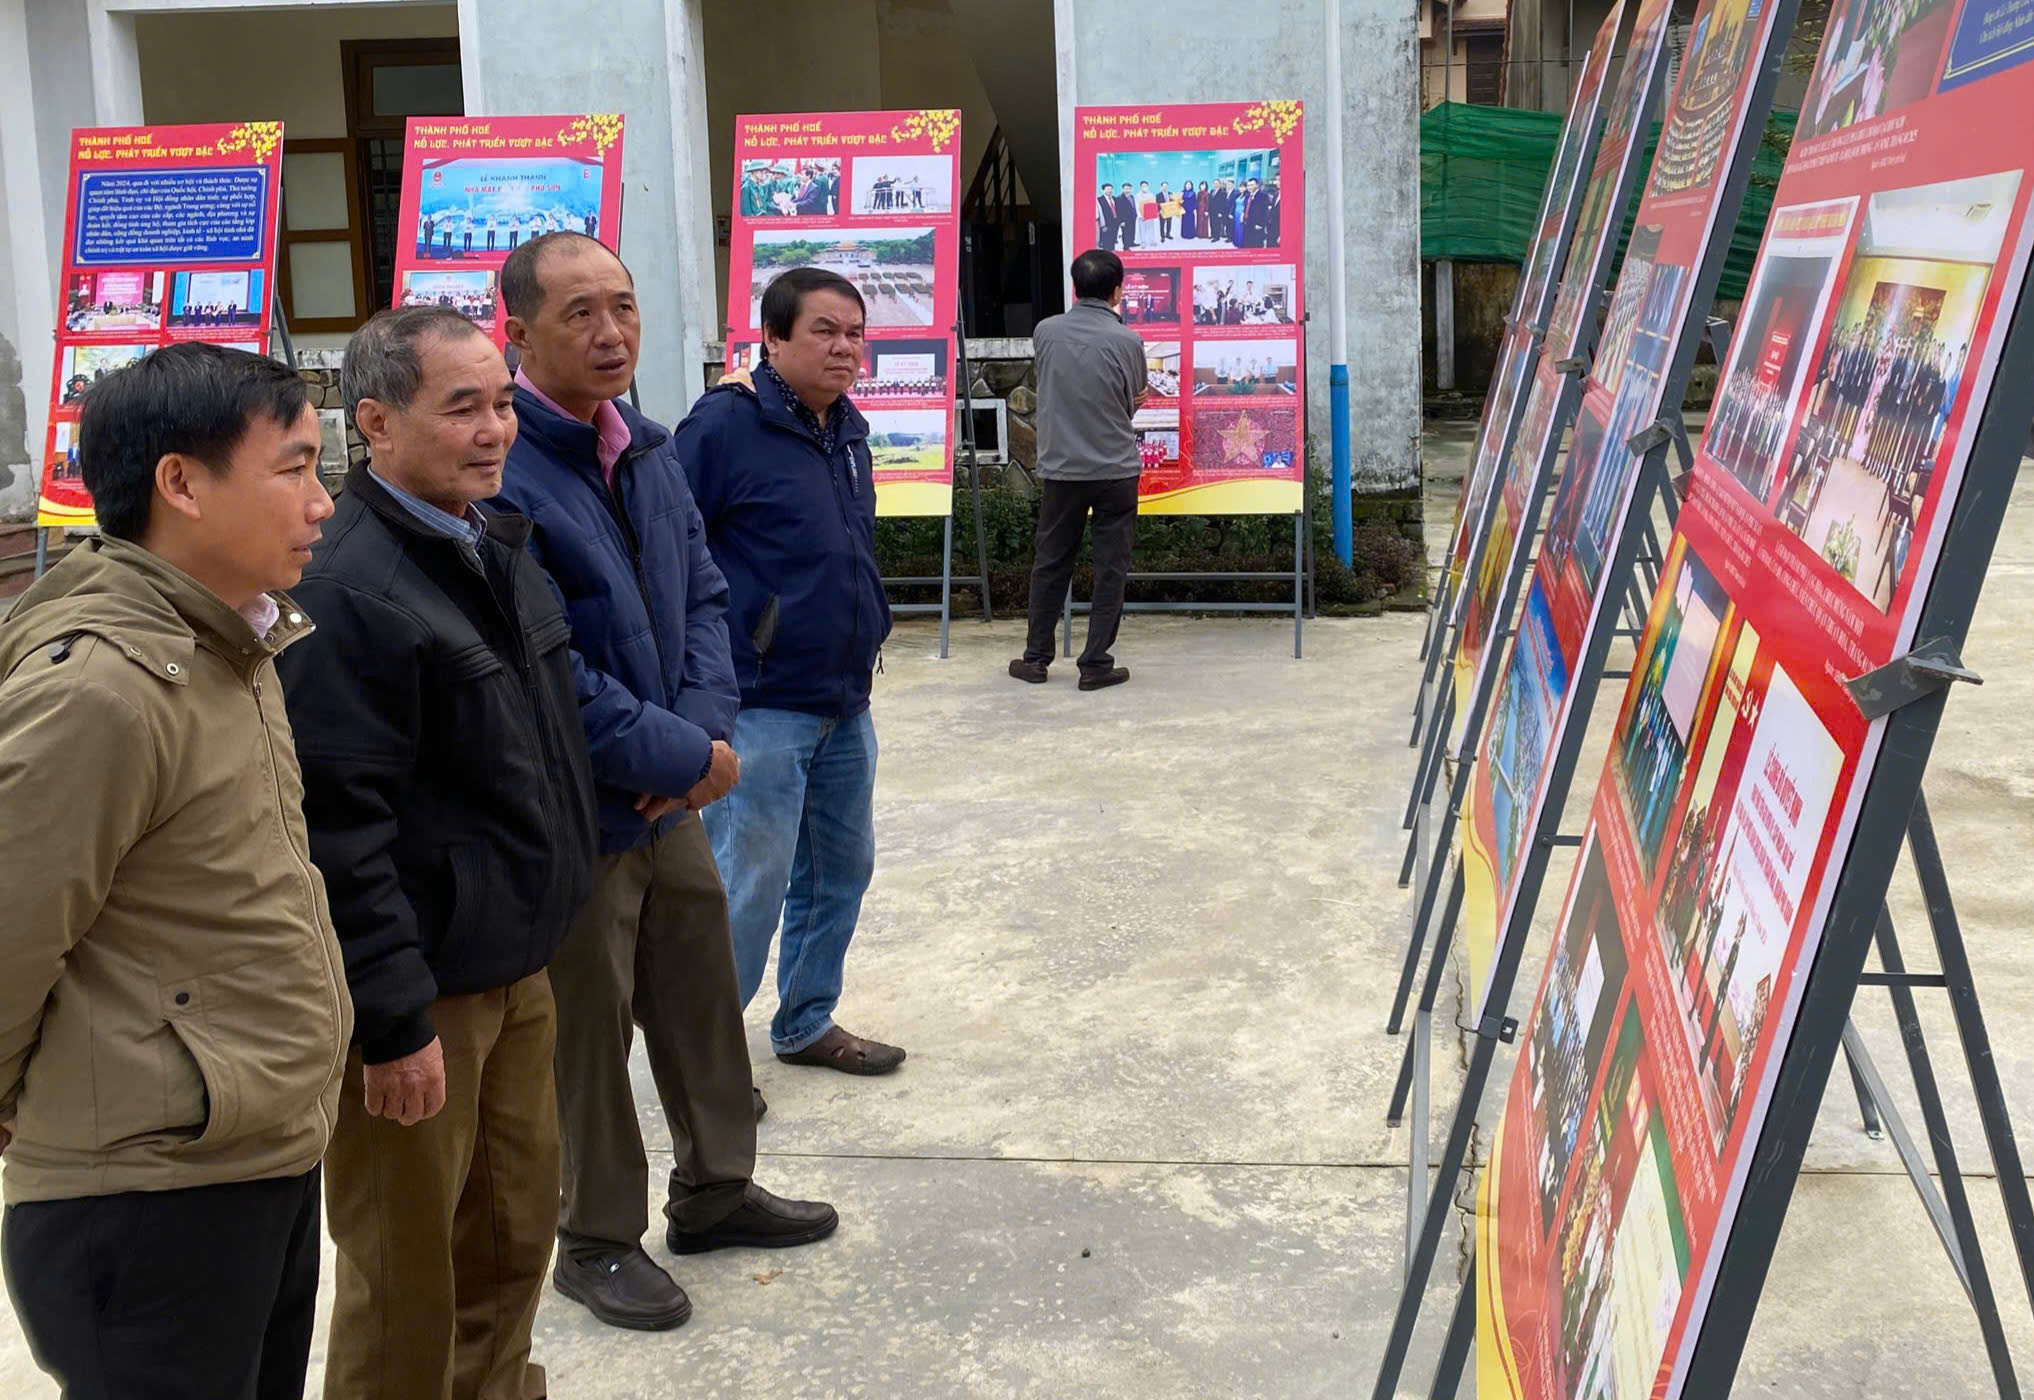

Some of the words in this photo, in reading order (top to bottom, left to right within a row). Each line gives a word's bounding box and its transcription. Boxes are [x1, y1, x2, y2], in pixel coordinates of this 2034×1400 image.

[1083, 115, 1116, 125] THÀNH
[1119, 112, 1139, 125] PHỐ
[1142, 112, 1162, 124] HUẾ
[414, 124, 447, 135] THÀNH
[450, 123, 469, 135] PHỐ
[471, 123, 491, 135] HUẾ
[744, 123, 777, 134] THÀNH
[780, 120, 800, 132] PHỐ
[802, 120, 823, 132] HUẾ
[1123, 127, 1149, 138] PHÁT
[79, 135, 110, 146] THÀNH
[112, 134, 132, 145] PHỐ
[134, 132, 152, 144] HUẾ
[453, 137, 477, 148] PHÁT
[784, 135, 809, 146] PHÁT
[115, 148, 139, 159] PHÁT
